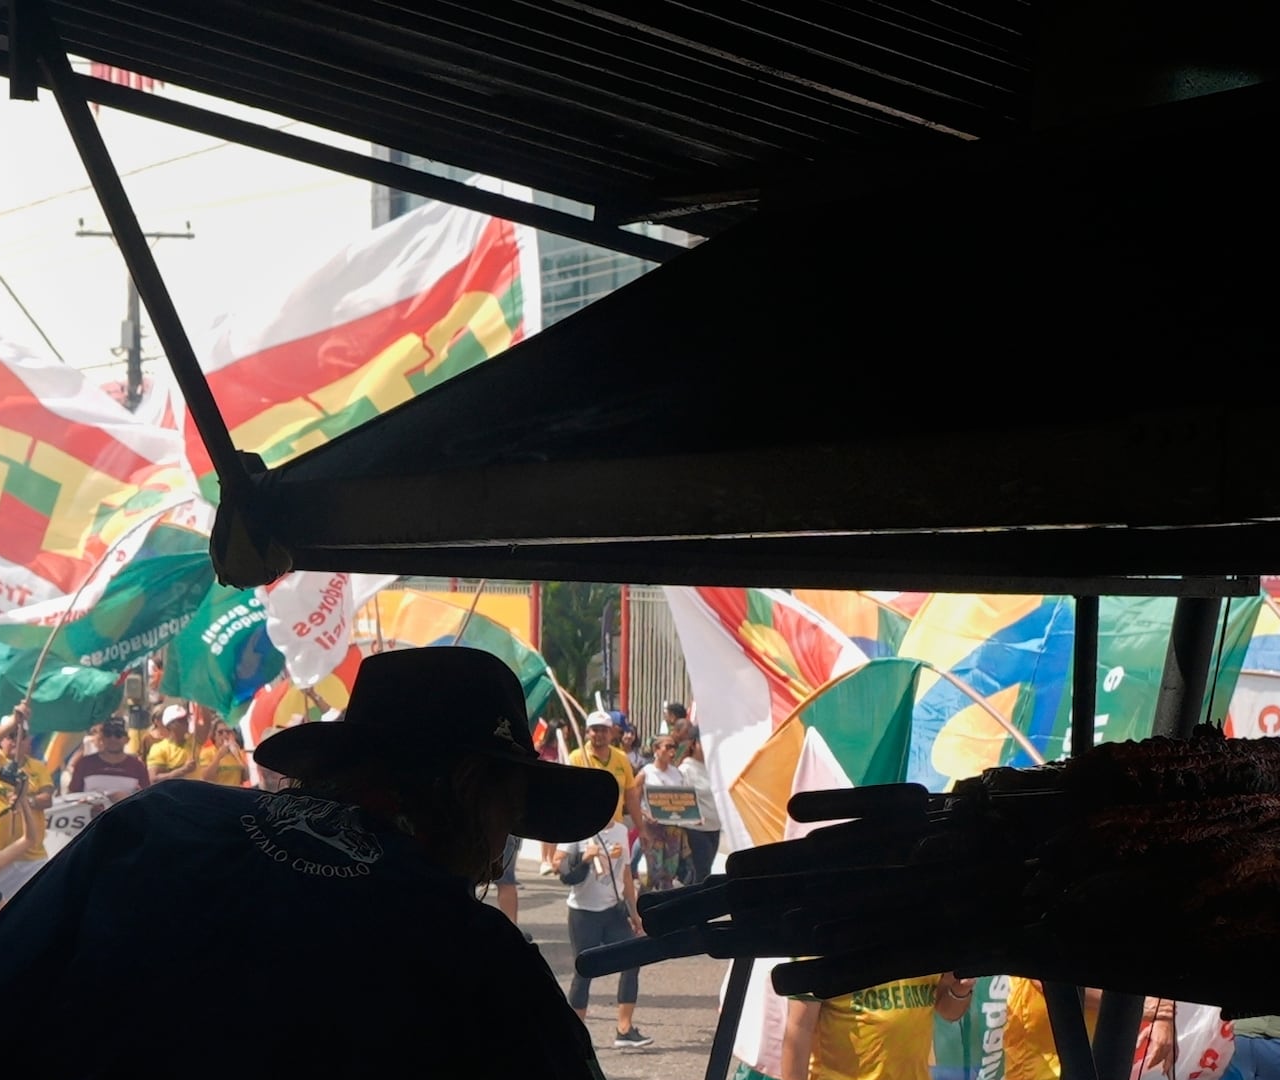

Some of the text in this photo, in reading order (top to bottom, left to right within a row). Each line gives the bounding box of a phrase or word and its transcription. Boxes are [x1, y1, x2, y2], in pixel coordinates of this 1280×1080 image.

[240, 815, 288, 862] CAVALO
[291, 858, 371, 878] CRIOULO
[850, 984, 937, 1013] SOBERAN
